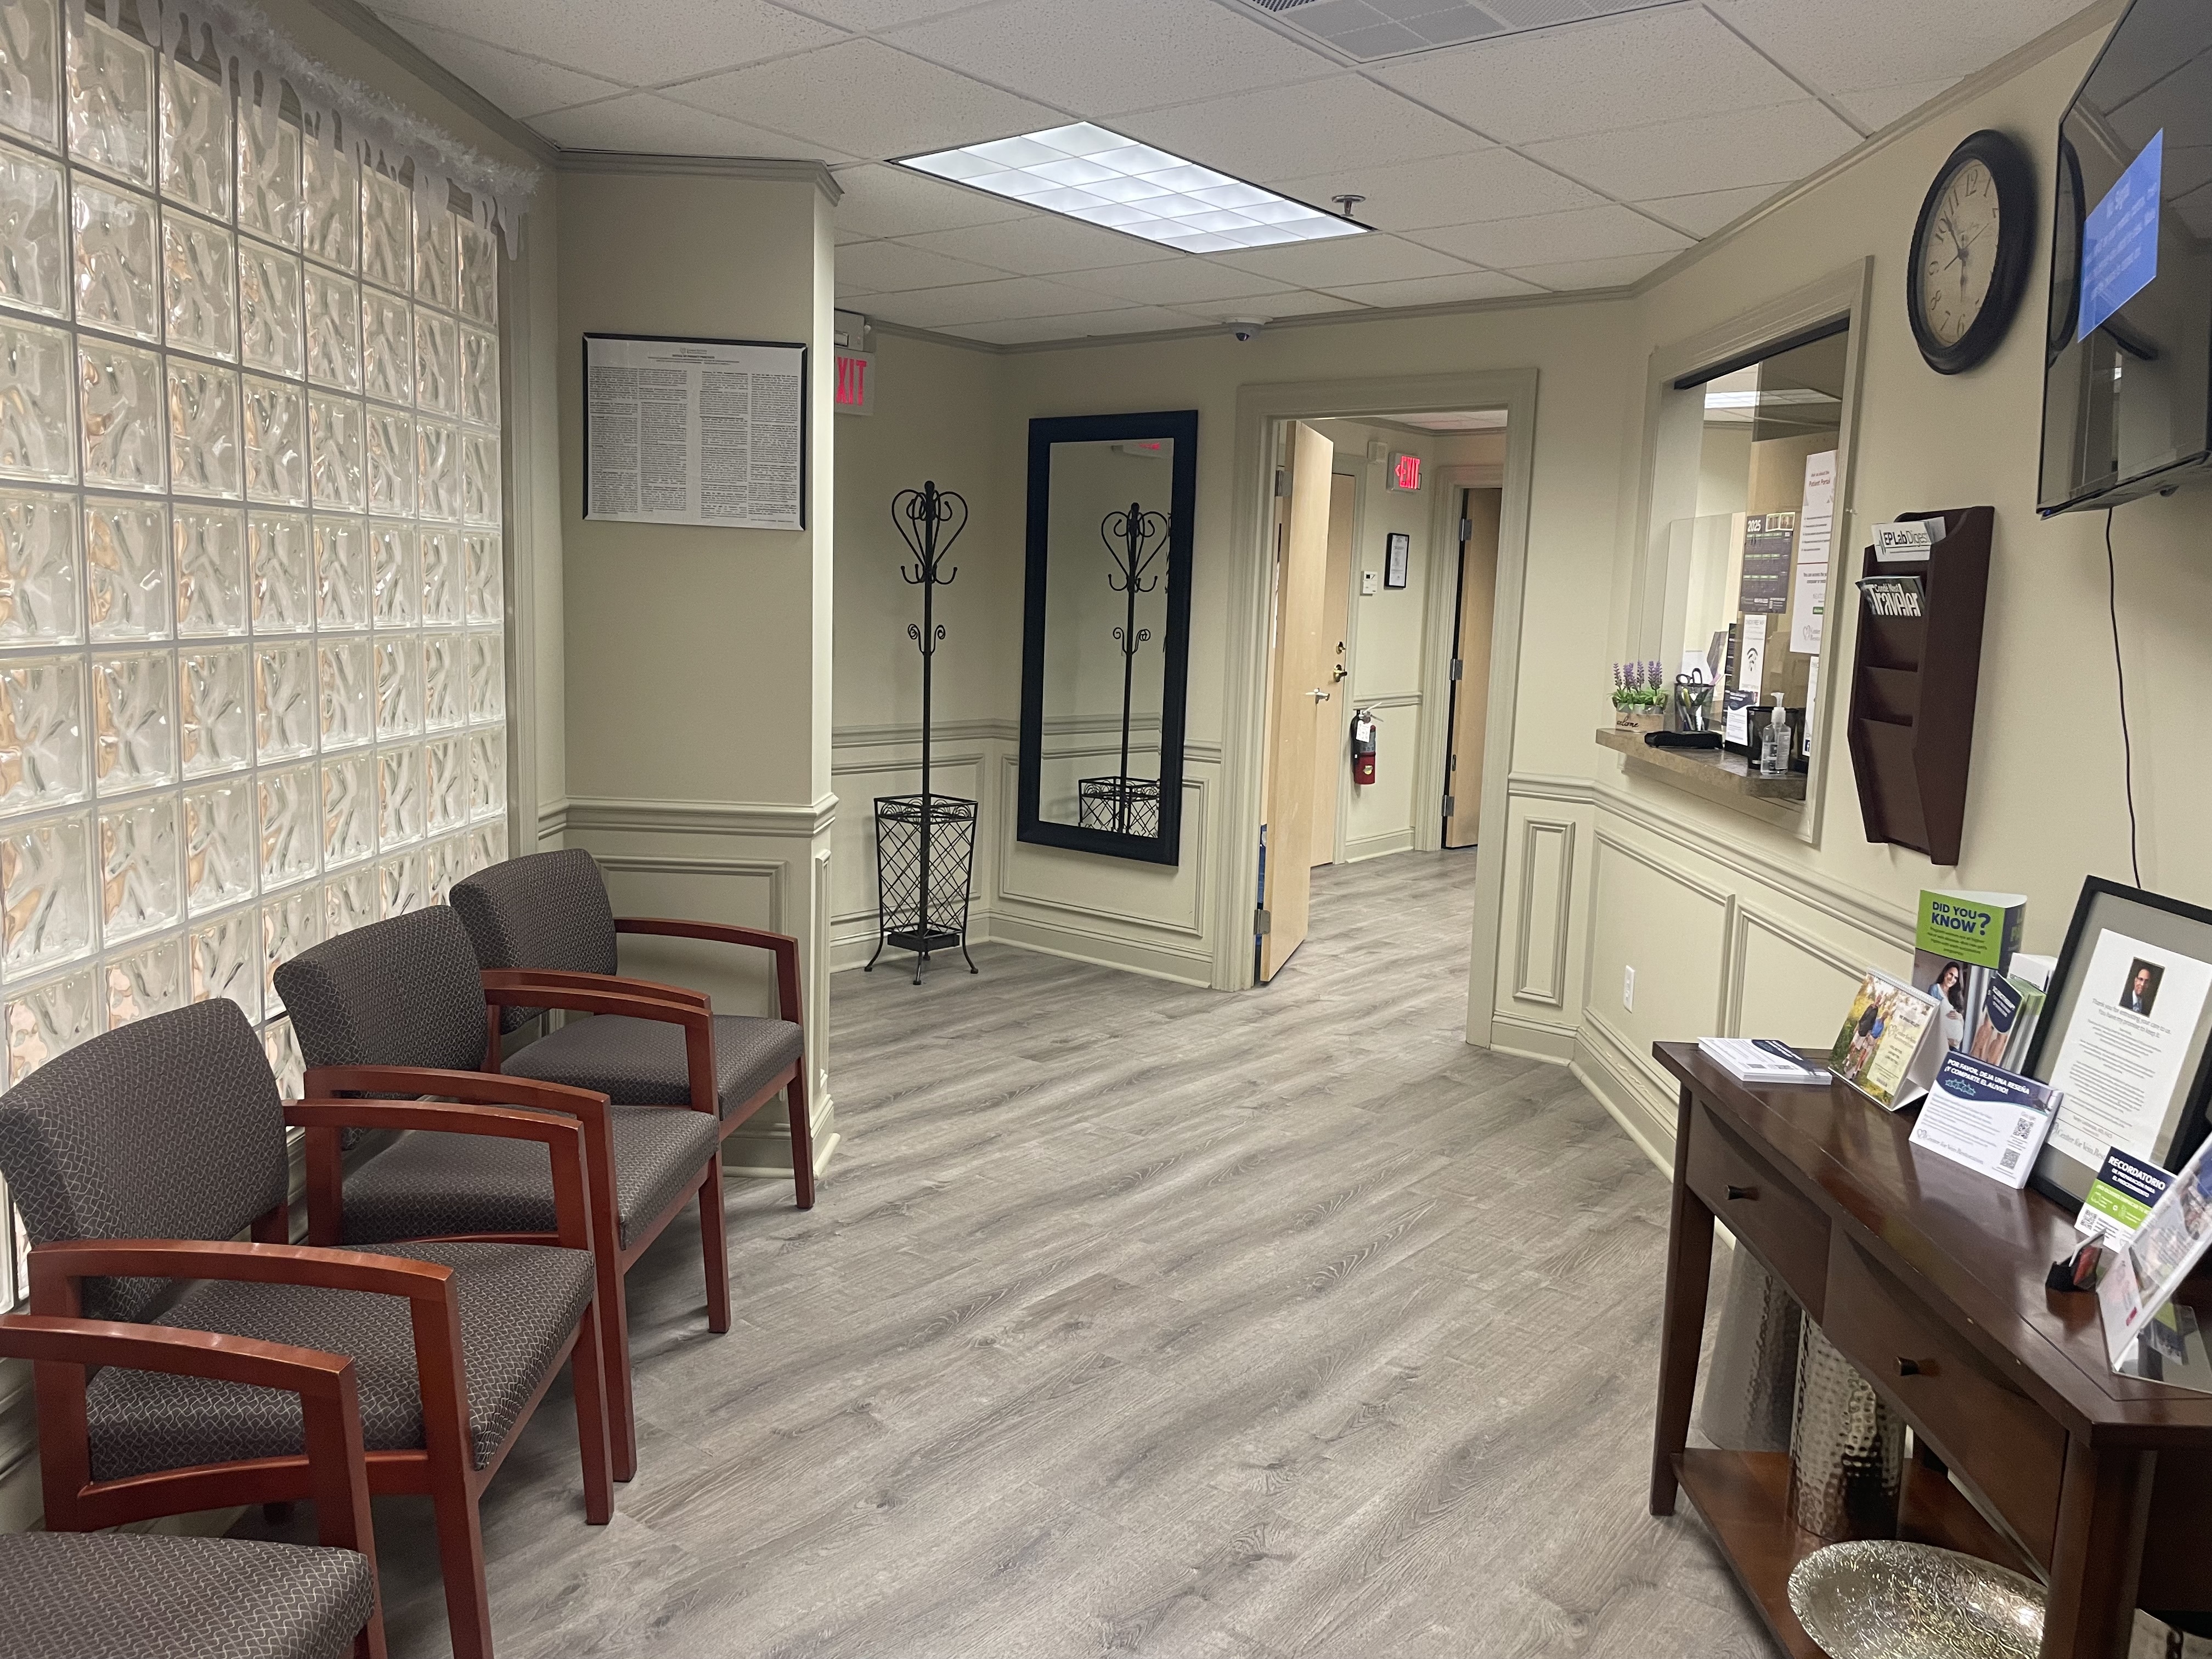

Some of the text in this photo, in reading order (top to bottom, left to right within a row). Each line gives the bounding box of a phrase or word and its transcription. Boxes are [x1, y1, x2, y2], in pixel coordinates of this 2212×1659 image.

[1965, 169, 1978, 197] 12
[1983, 176, 1991, 198] 1
[1931, 290, 1942, 311] 8
[1940, 310, 1951, 331] 7
[1957, 314, 1965, 338] 6
[836, 356, 867, 406] XIT
[1400, 456, 1420, 489] EXIT
[1747, 520, 1762, 532] 2025
[1883, 532, 1893, 545] EP
[1892, 530, 1908, 545] Lab
[1864, 583, 1921, 617] Traveler
[1932, 901, 1977, 919] DID YOU
[2092, 998, 2104, 1007] Thank
[1947, 1058, 1960, 1069] POR
[1959, 1063, 1979, 1076] FAVOR,
[1979, 1070, 1994, 1081] DEJA
[1994, 1076, 2007, 1086] UNA
[1951, 1068, 1981, 1084] COMPARTE
[2074, 1138, 2083, 1148] for
[2108, 1155, 2166, 1191] RECORDATORIO
